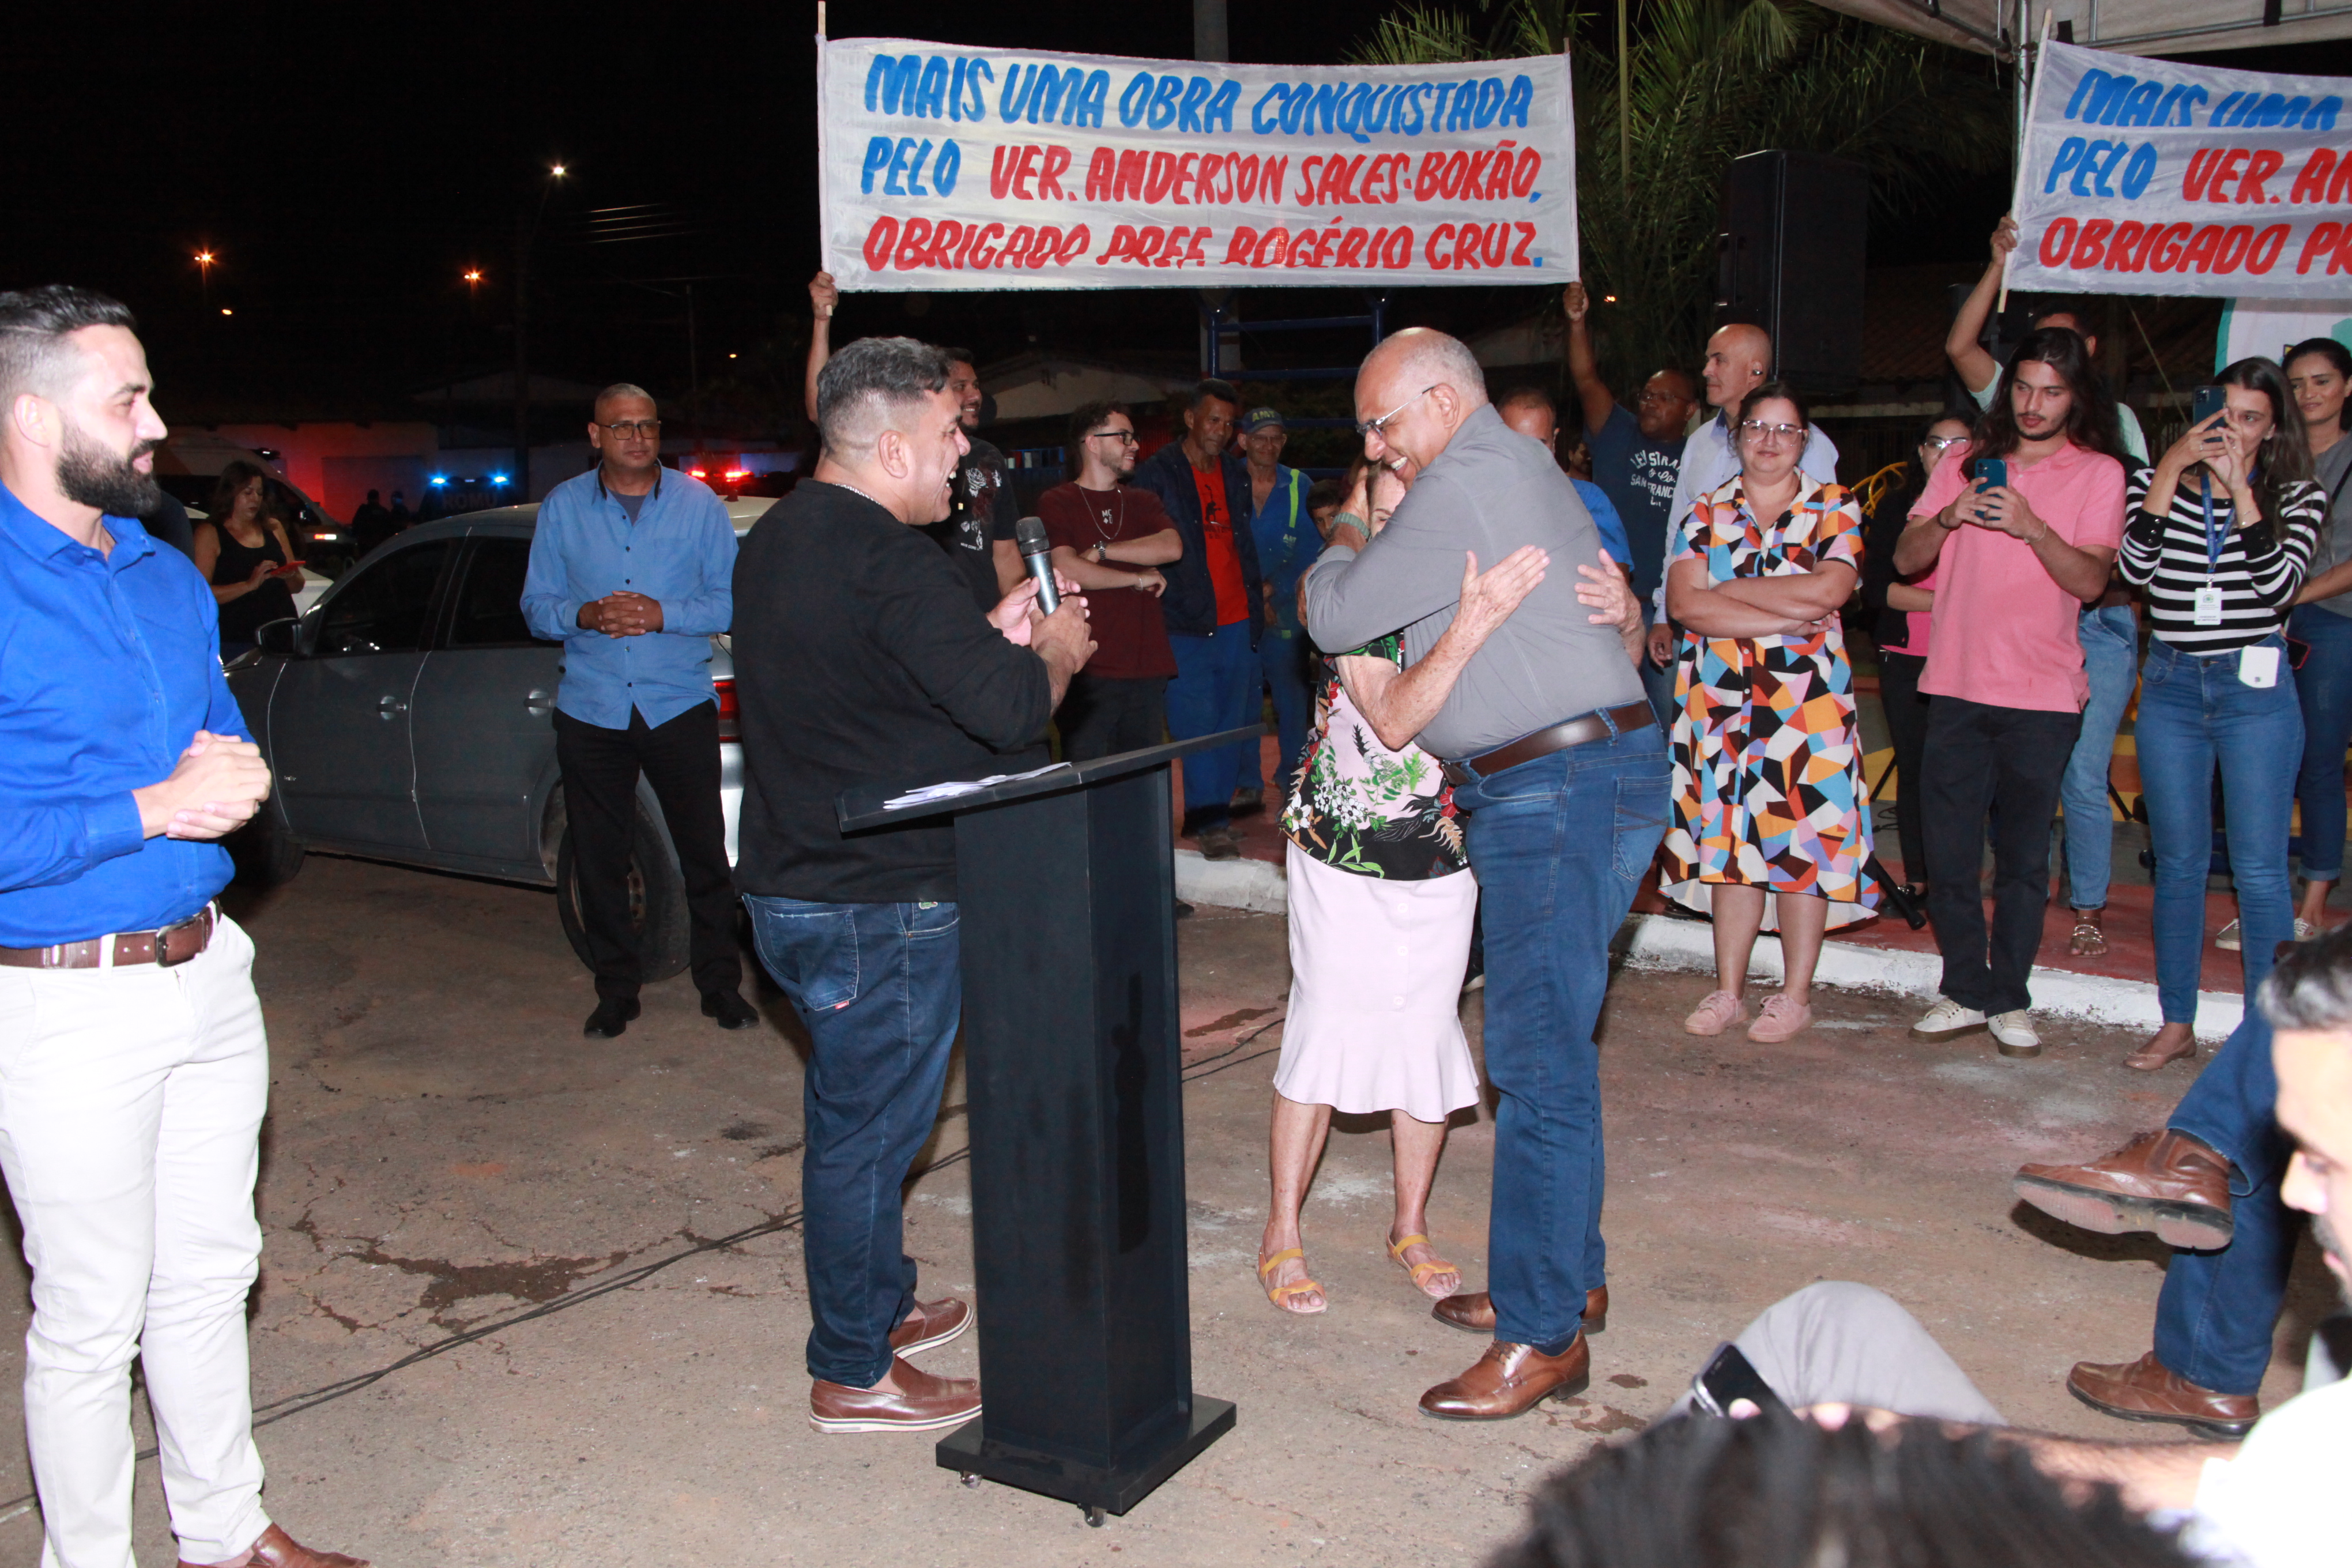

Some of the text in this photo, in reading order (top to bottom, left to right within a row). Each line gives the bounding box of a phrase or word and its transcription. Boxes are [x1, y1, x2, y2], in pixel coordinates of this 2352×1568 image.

[865, 55, 1533, 143] MAIS UMA OBRA CONQUISTADA
[2065, 69, 2208, 126] MAIS
[862, 137, 960, 195] PELO
[992, 146, 1077, 200] VER.
[1086, 148, 1288, 204] ANDERSON
[2045, 137, 2157, 199] PELO
[2183, 149, 2283, 204] VER.
[864, 216, 1090, 271] OBRIGADO
[1220, 216, 1414, 269] ROGÉRIO
[1425, 222, 1543, 270] CRUZ.
[2040, 217, 2291, 274] OBRIGADO
[443, 492, 497, 510] ROMU
[1630, 474, 1647, 487] SAN
